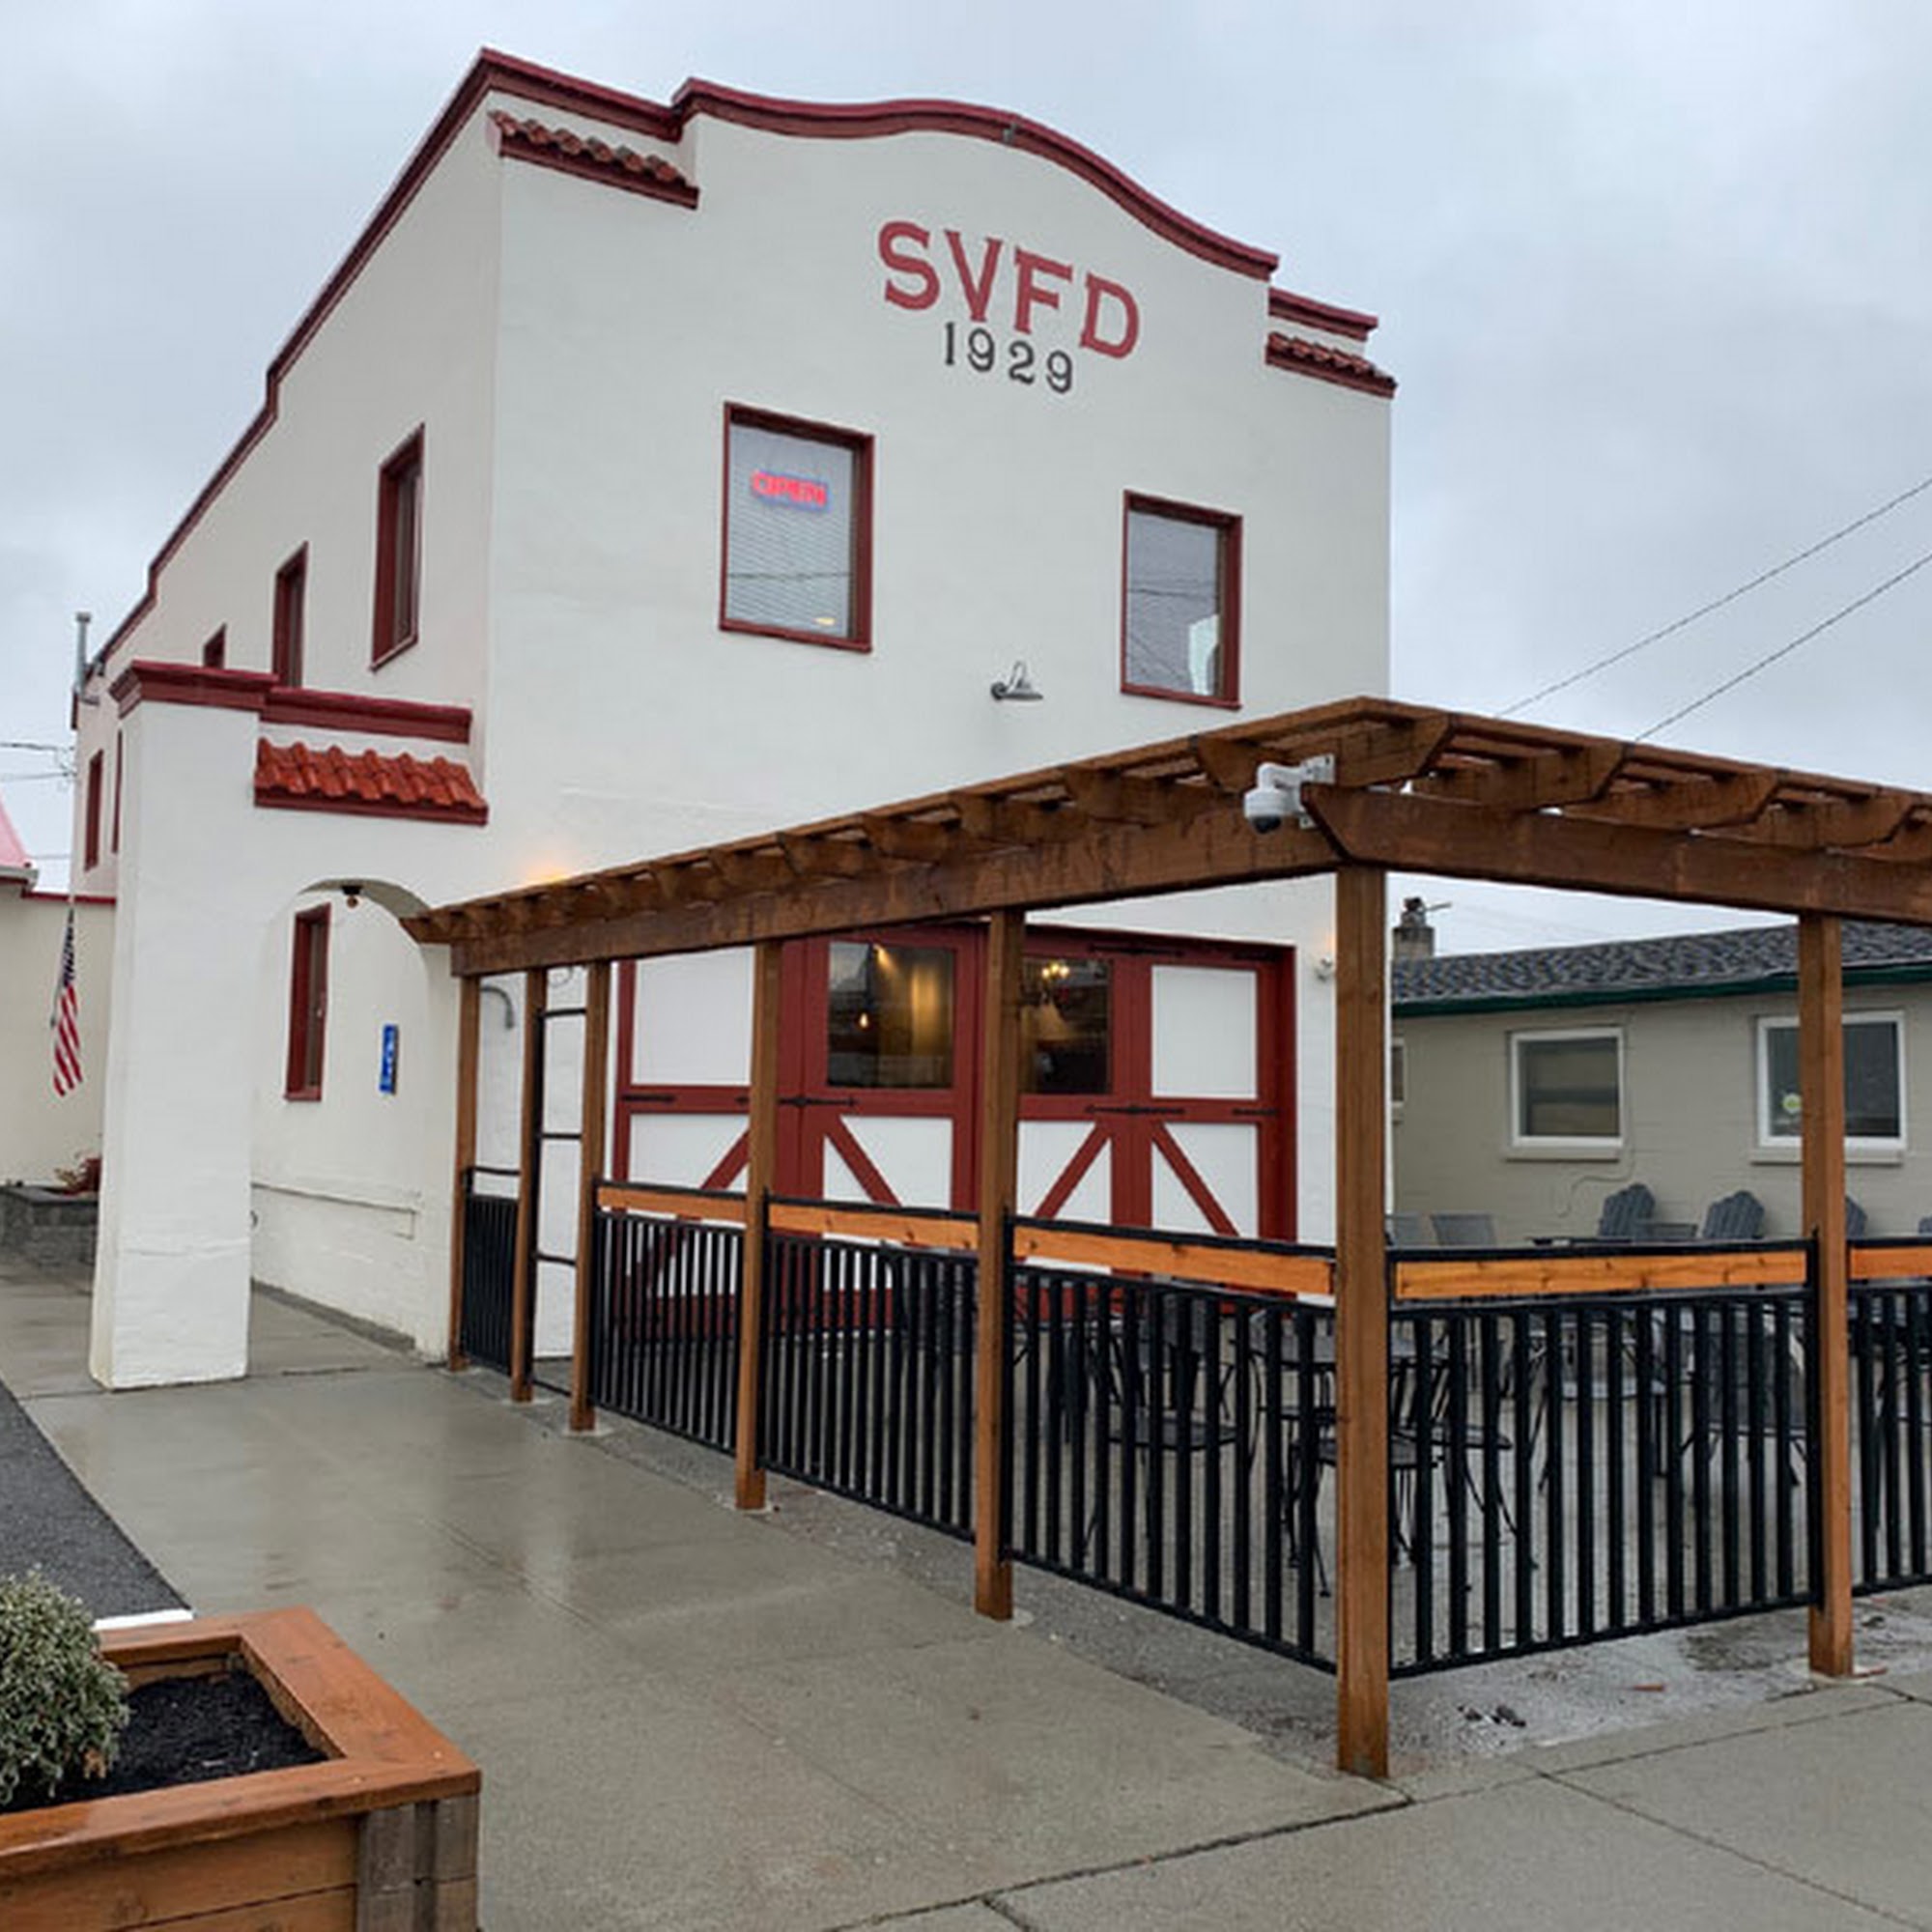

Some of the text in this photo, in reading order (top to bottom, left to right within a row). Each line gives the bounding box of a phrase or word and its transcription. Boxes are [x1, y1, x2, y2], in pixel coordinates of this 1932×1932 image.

[878, 221, 1140, 359] SVFD
[944, 321, 1073, 394] 1929
[751, 469, 828, 508] OPEN
